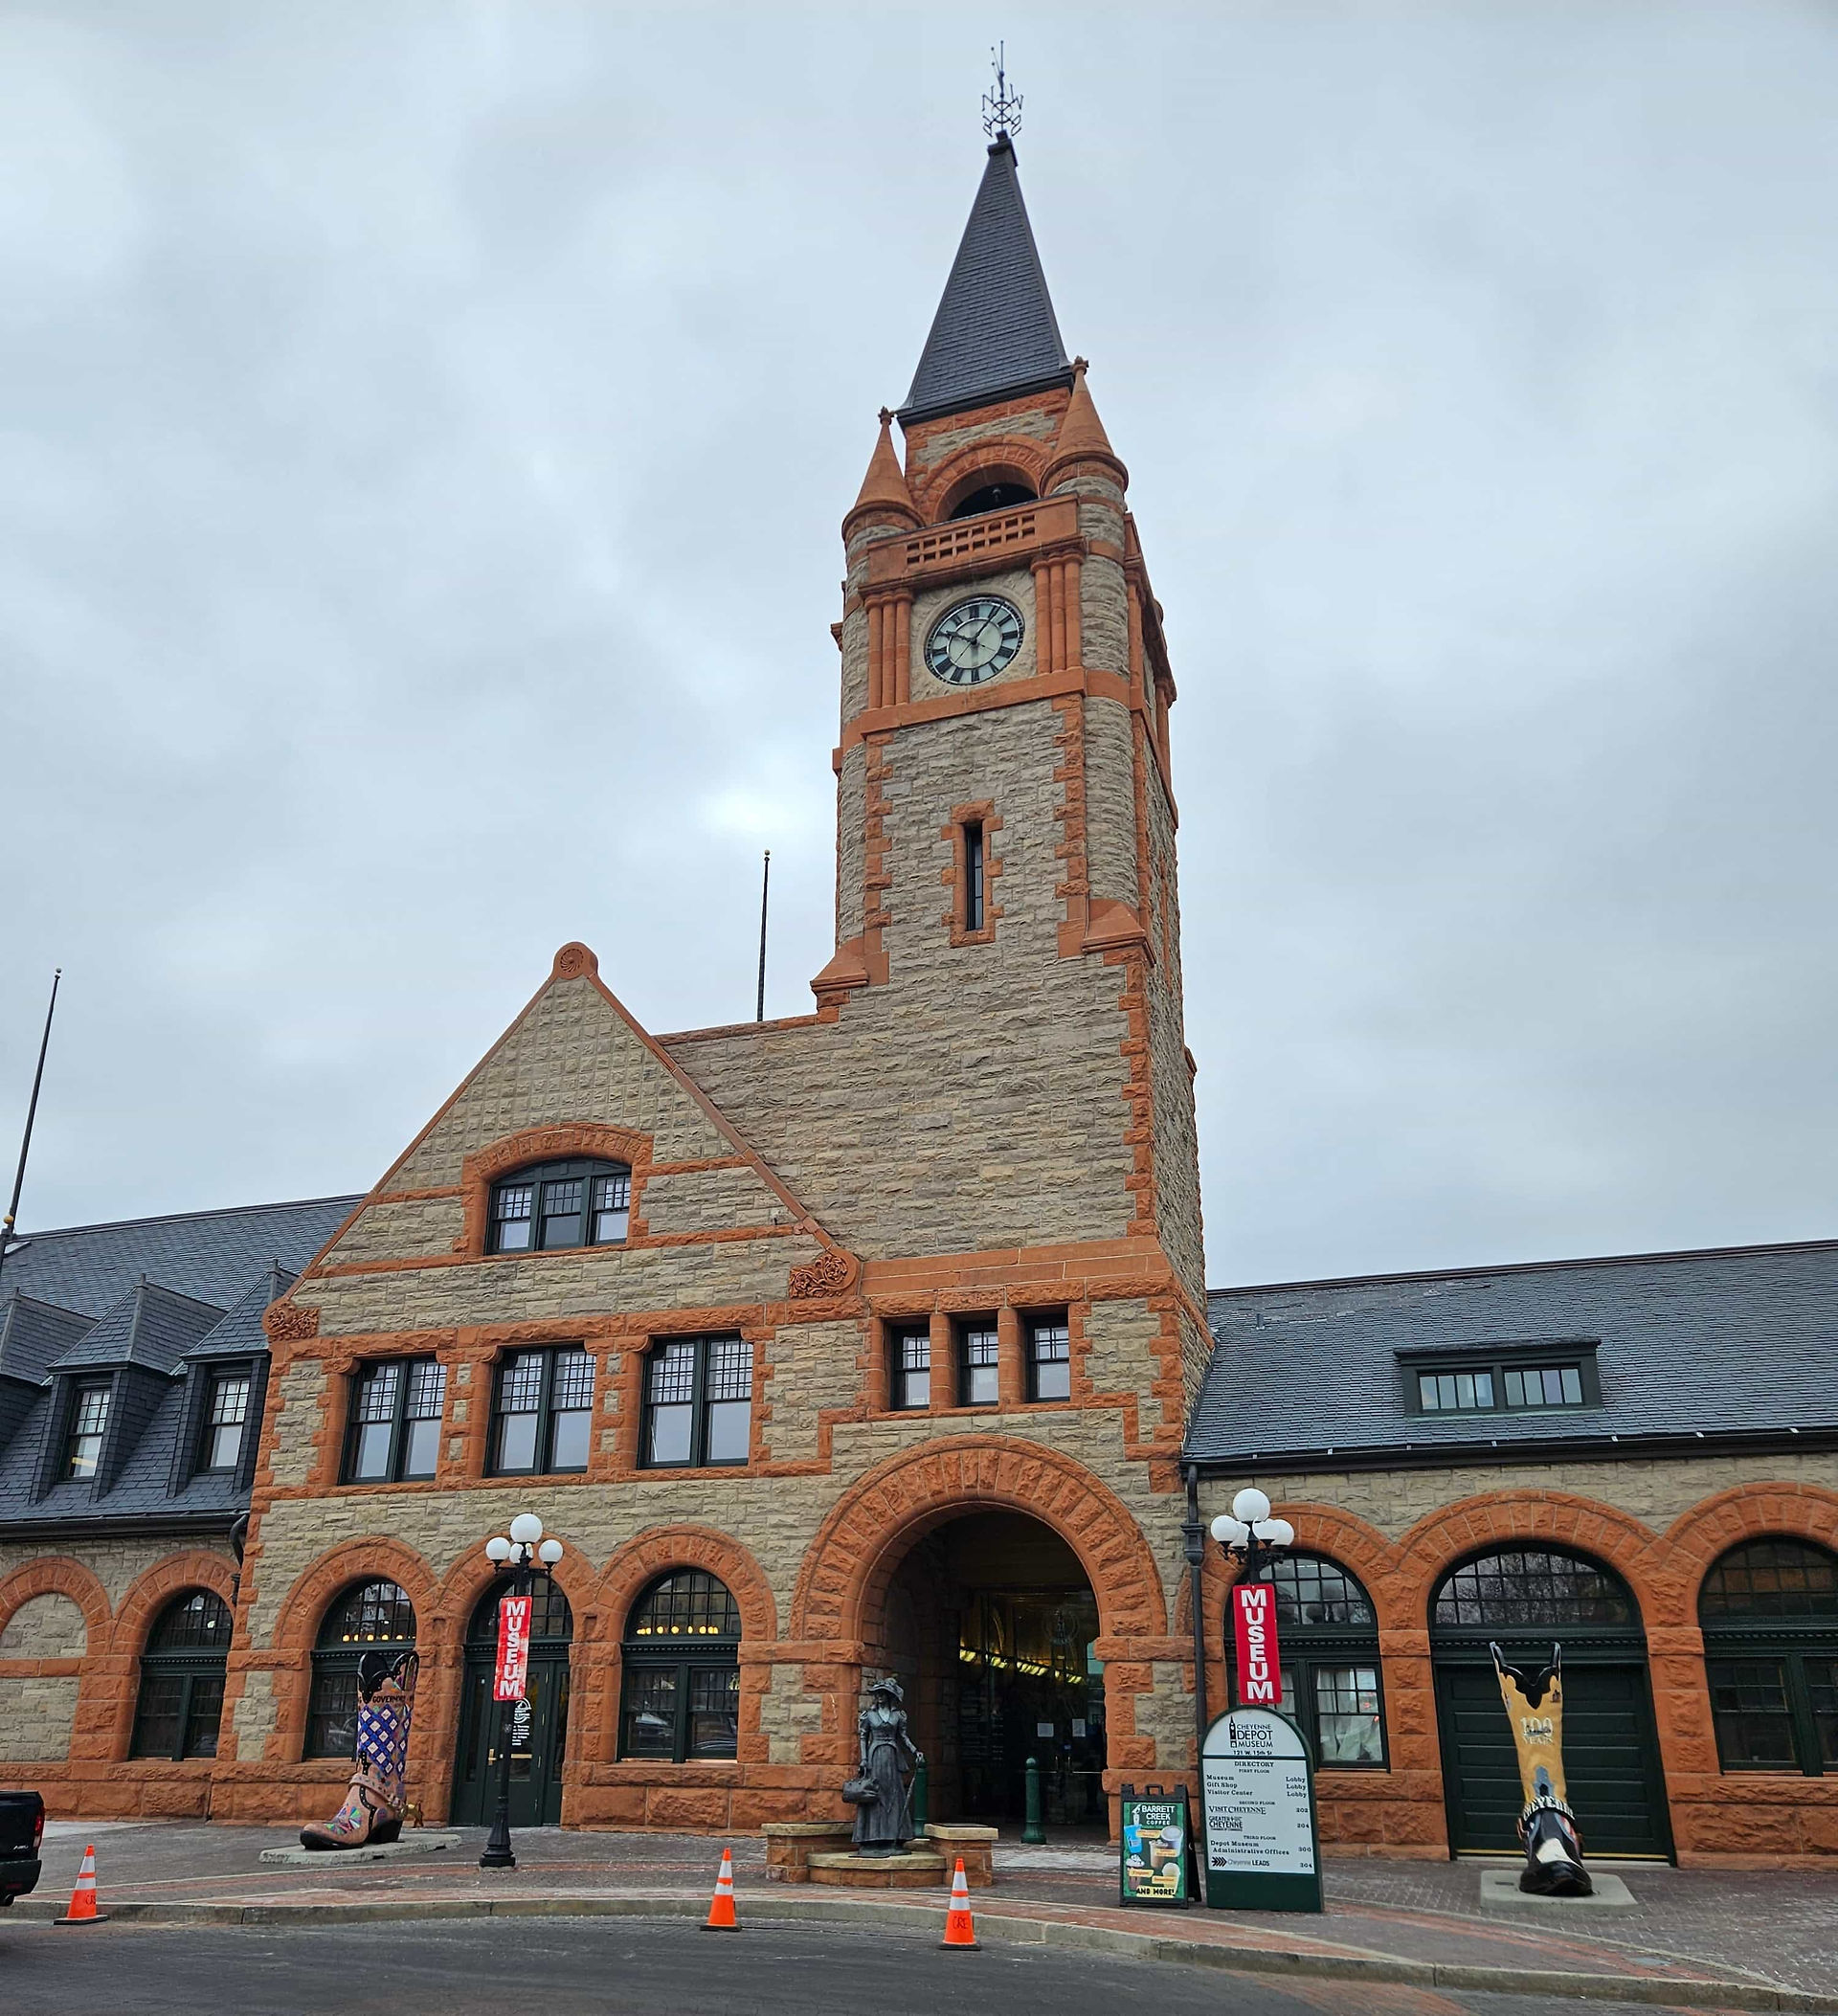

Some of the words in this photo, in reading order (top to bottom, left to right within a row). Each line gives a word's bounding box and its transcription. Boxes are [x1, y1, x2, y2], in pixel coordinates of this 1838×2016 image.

[499, 1601, 526, 1697] MUSEUM
[1241, 1589, 1274, 1700] MUSEUM
[1237, 1730, 1273, 1740] DEPOT
[1141, 1804, 1176, 1813] BARRETT
